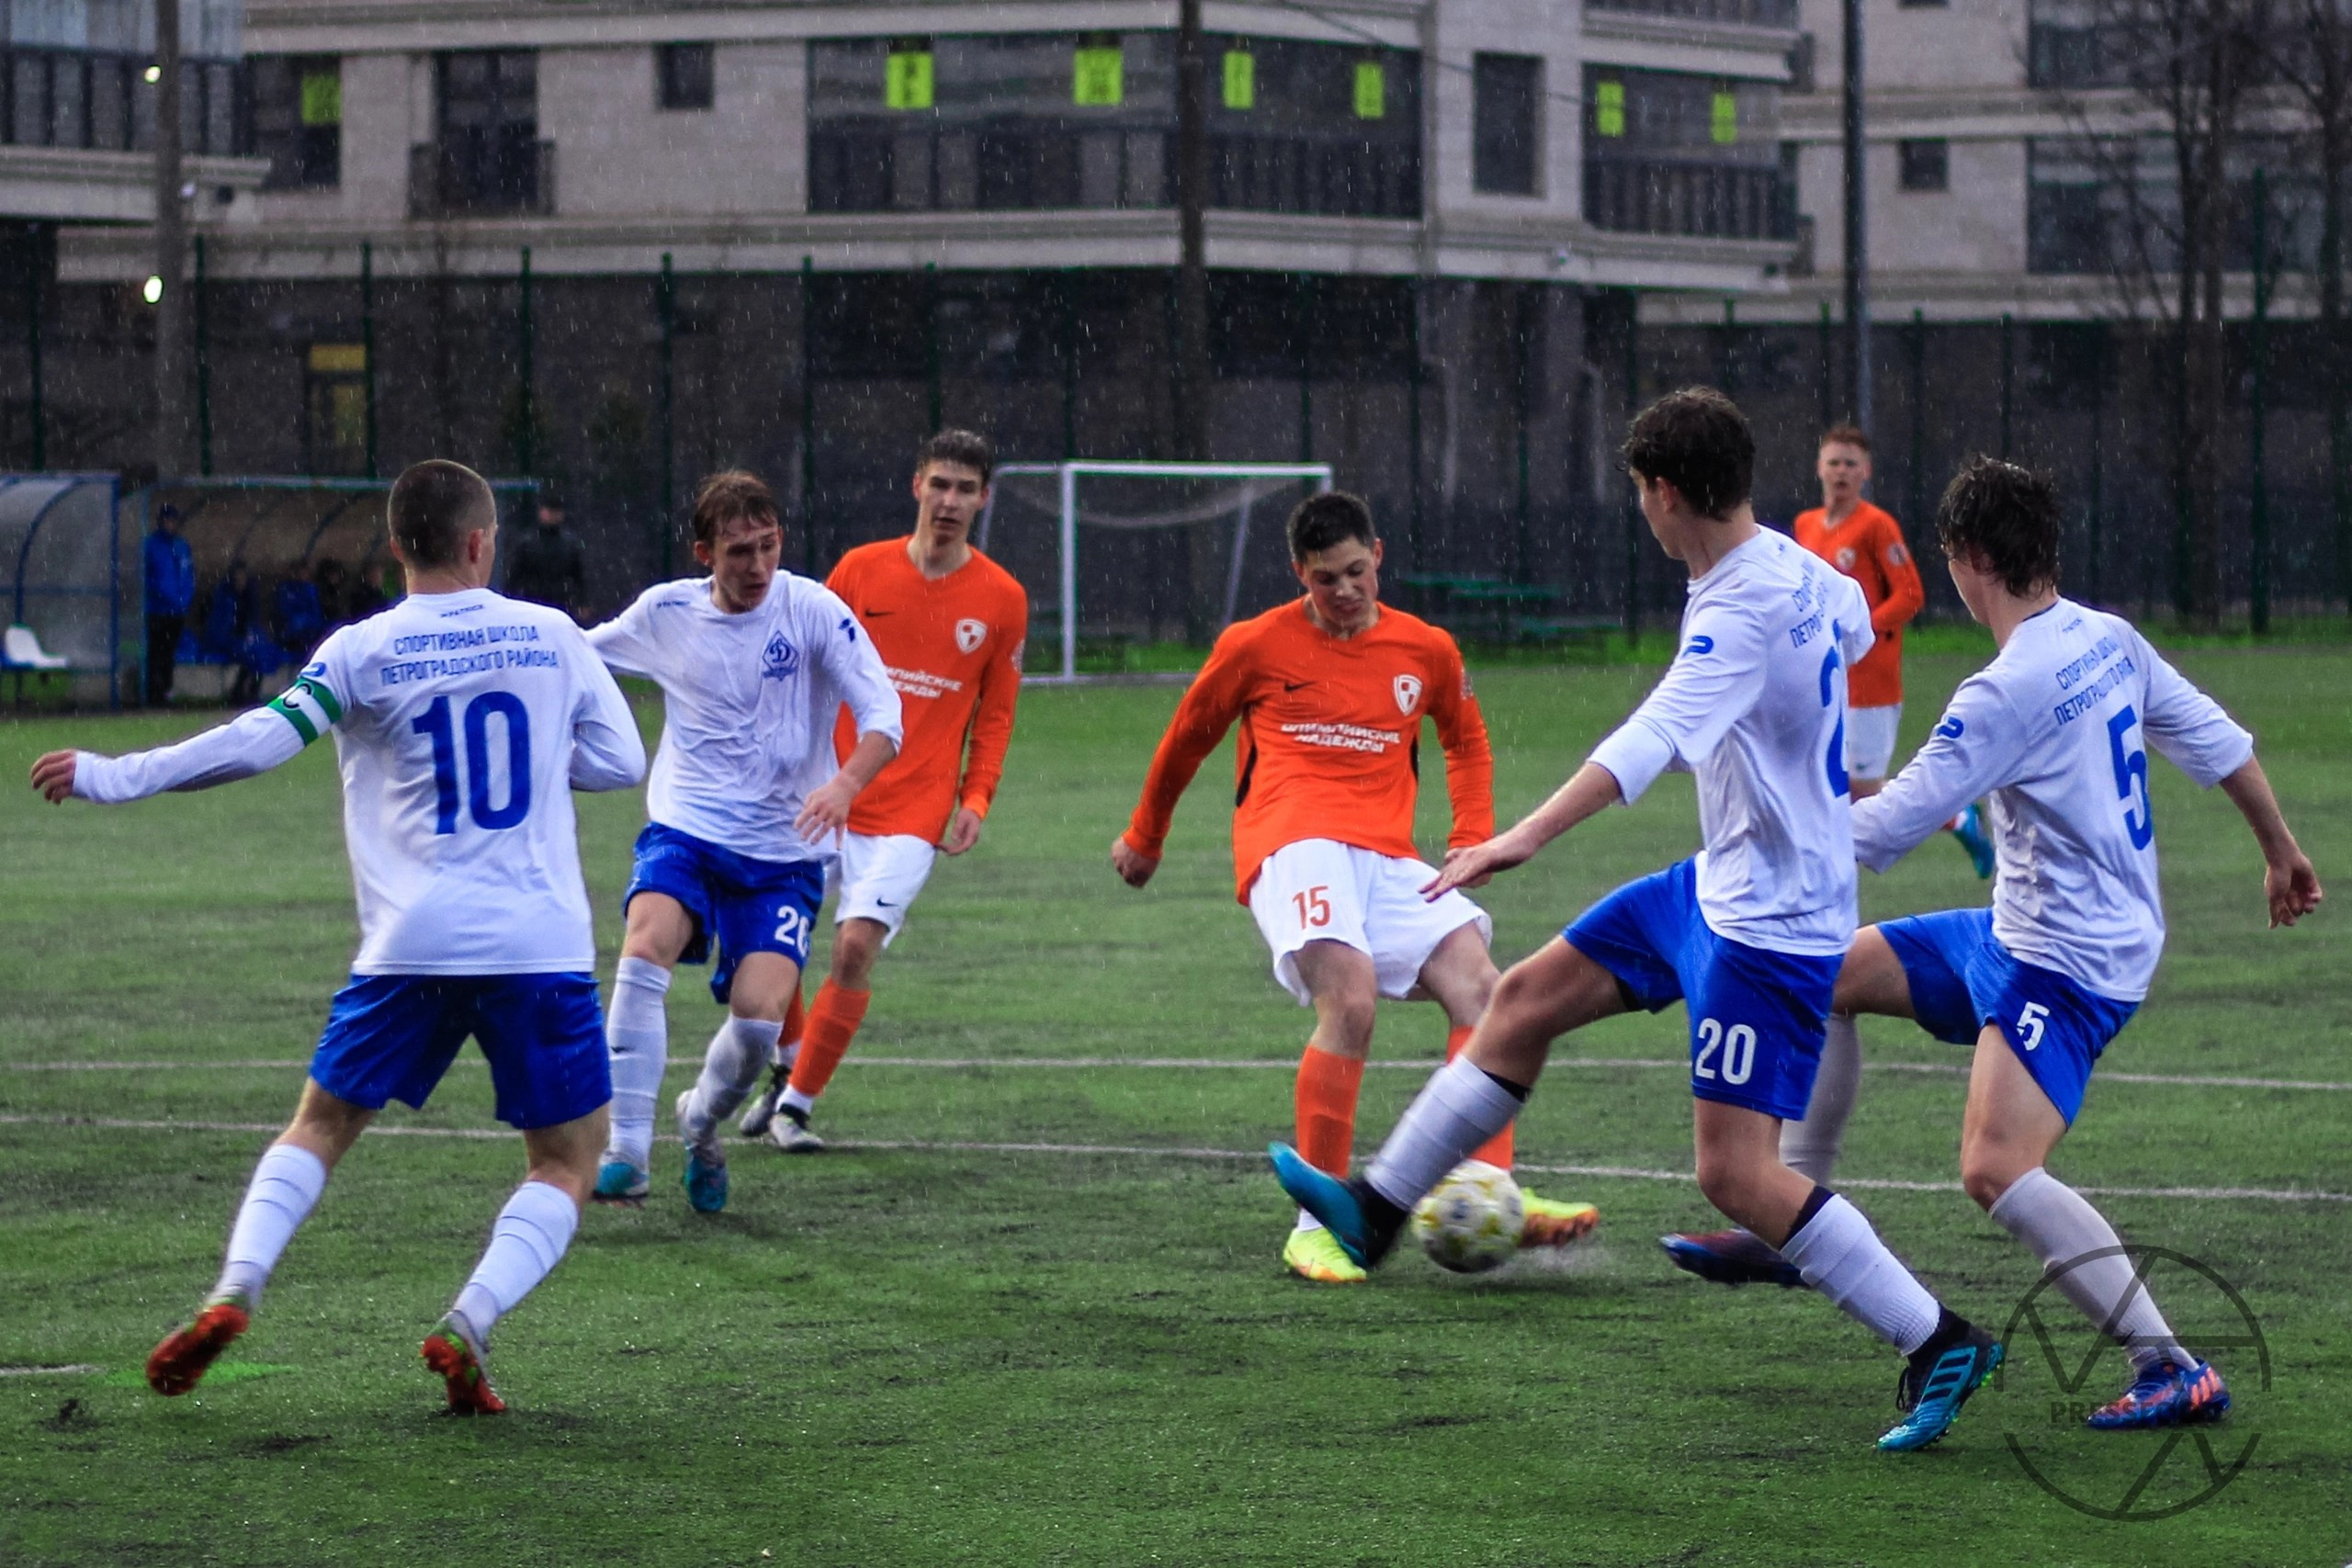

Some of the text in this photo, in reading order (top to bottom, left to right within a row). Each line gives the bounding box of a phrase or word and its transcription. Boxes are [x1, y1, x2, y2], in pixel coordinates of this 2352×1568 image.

[393, 626, 540, 655] СПОРТИВНАЯ ШКОЛА
[379, 648, 559, 686] ПЕТРОГРАДСКОГО РАЙОНА
[411, 691, 532, 835] 10
[2107, 705, 2153, 851] 5
[1292, 886, 1330, 930] 15
[2017, 1001, 2050, 1051] 5
[1695, 1018, 1757, 1086] 20
